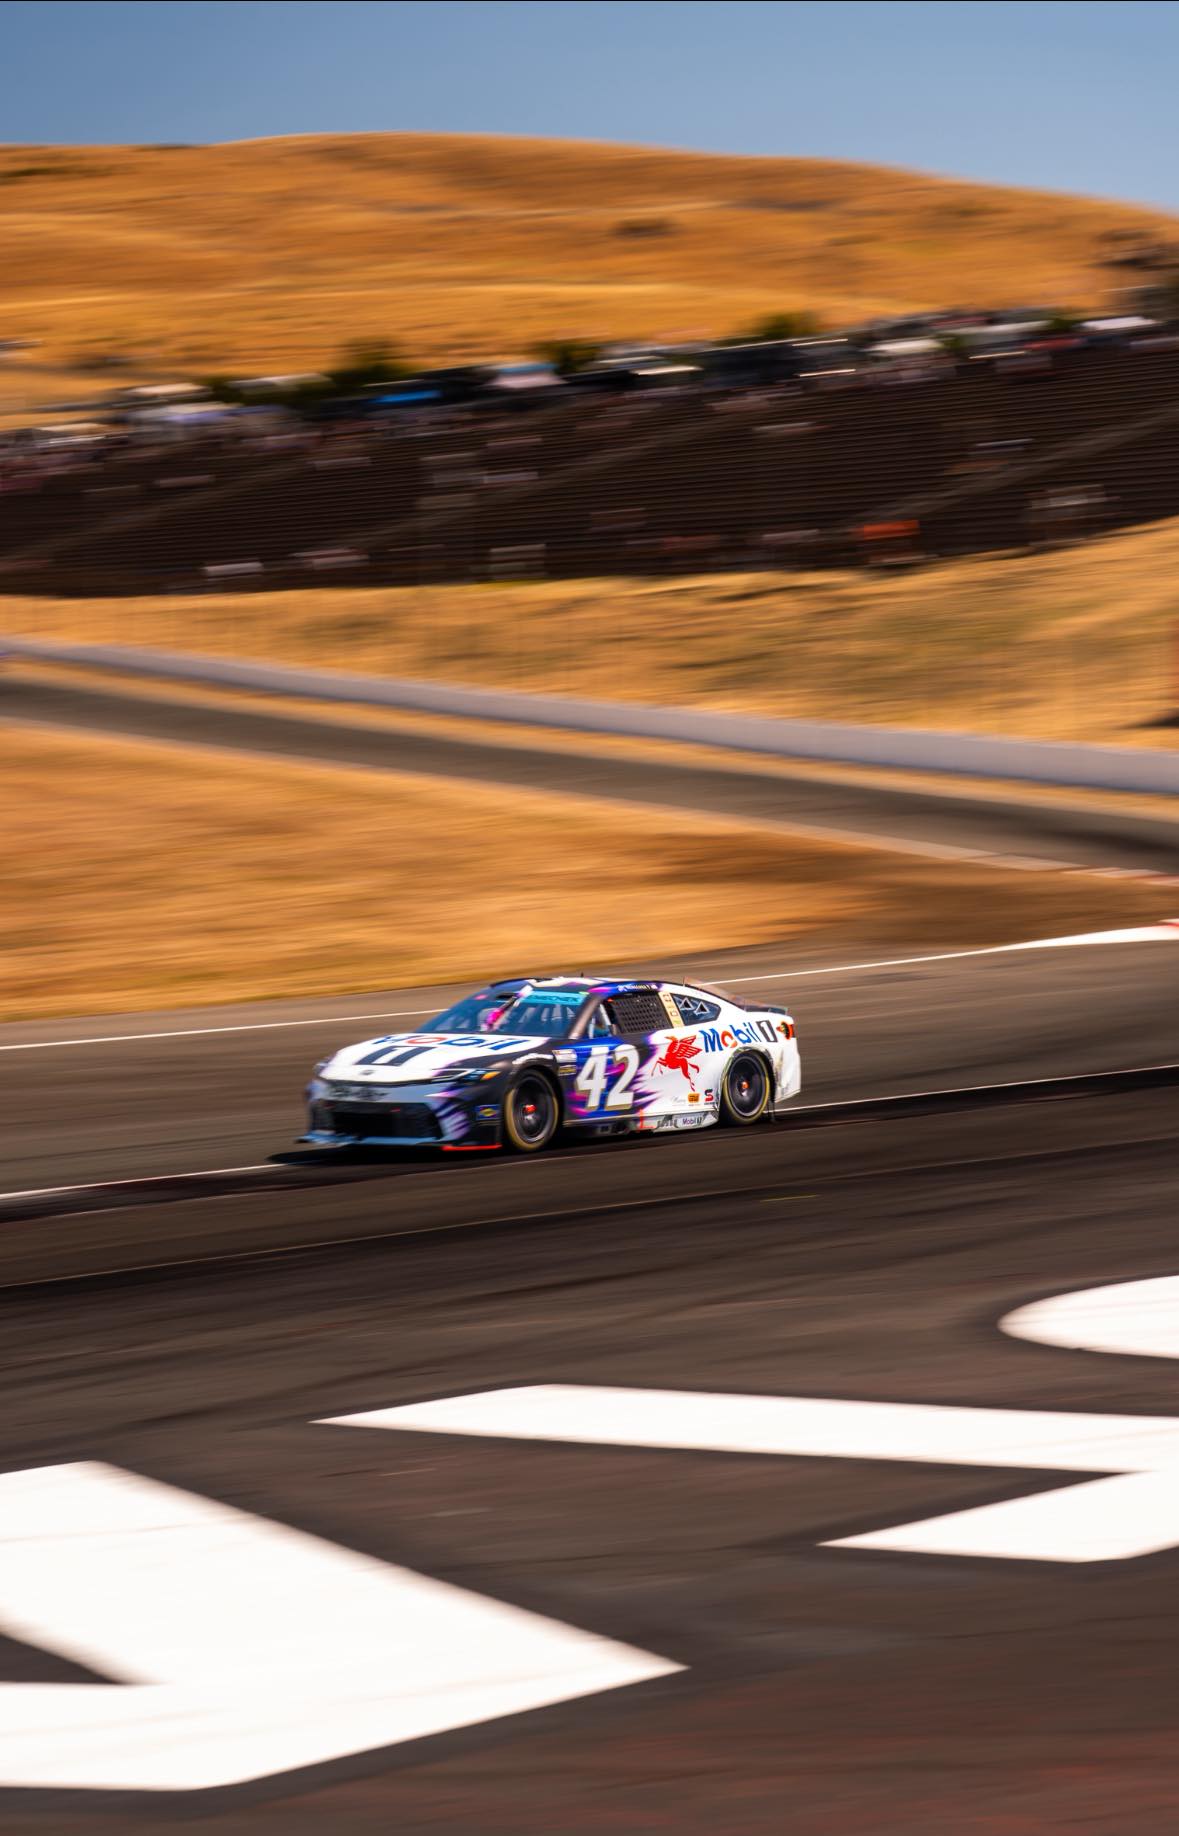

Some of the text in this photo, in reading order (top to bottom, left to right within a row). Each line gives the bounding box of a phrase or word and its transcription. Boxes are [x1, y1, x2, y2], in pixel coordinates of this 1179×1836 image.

[698, 1020, 778, 1053] Mobil 1
[575, 1043, 639, 1110] 42
